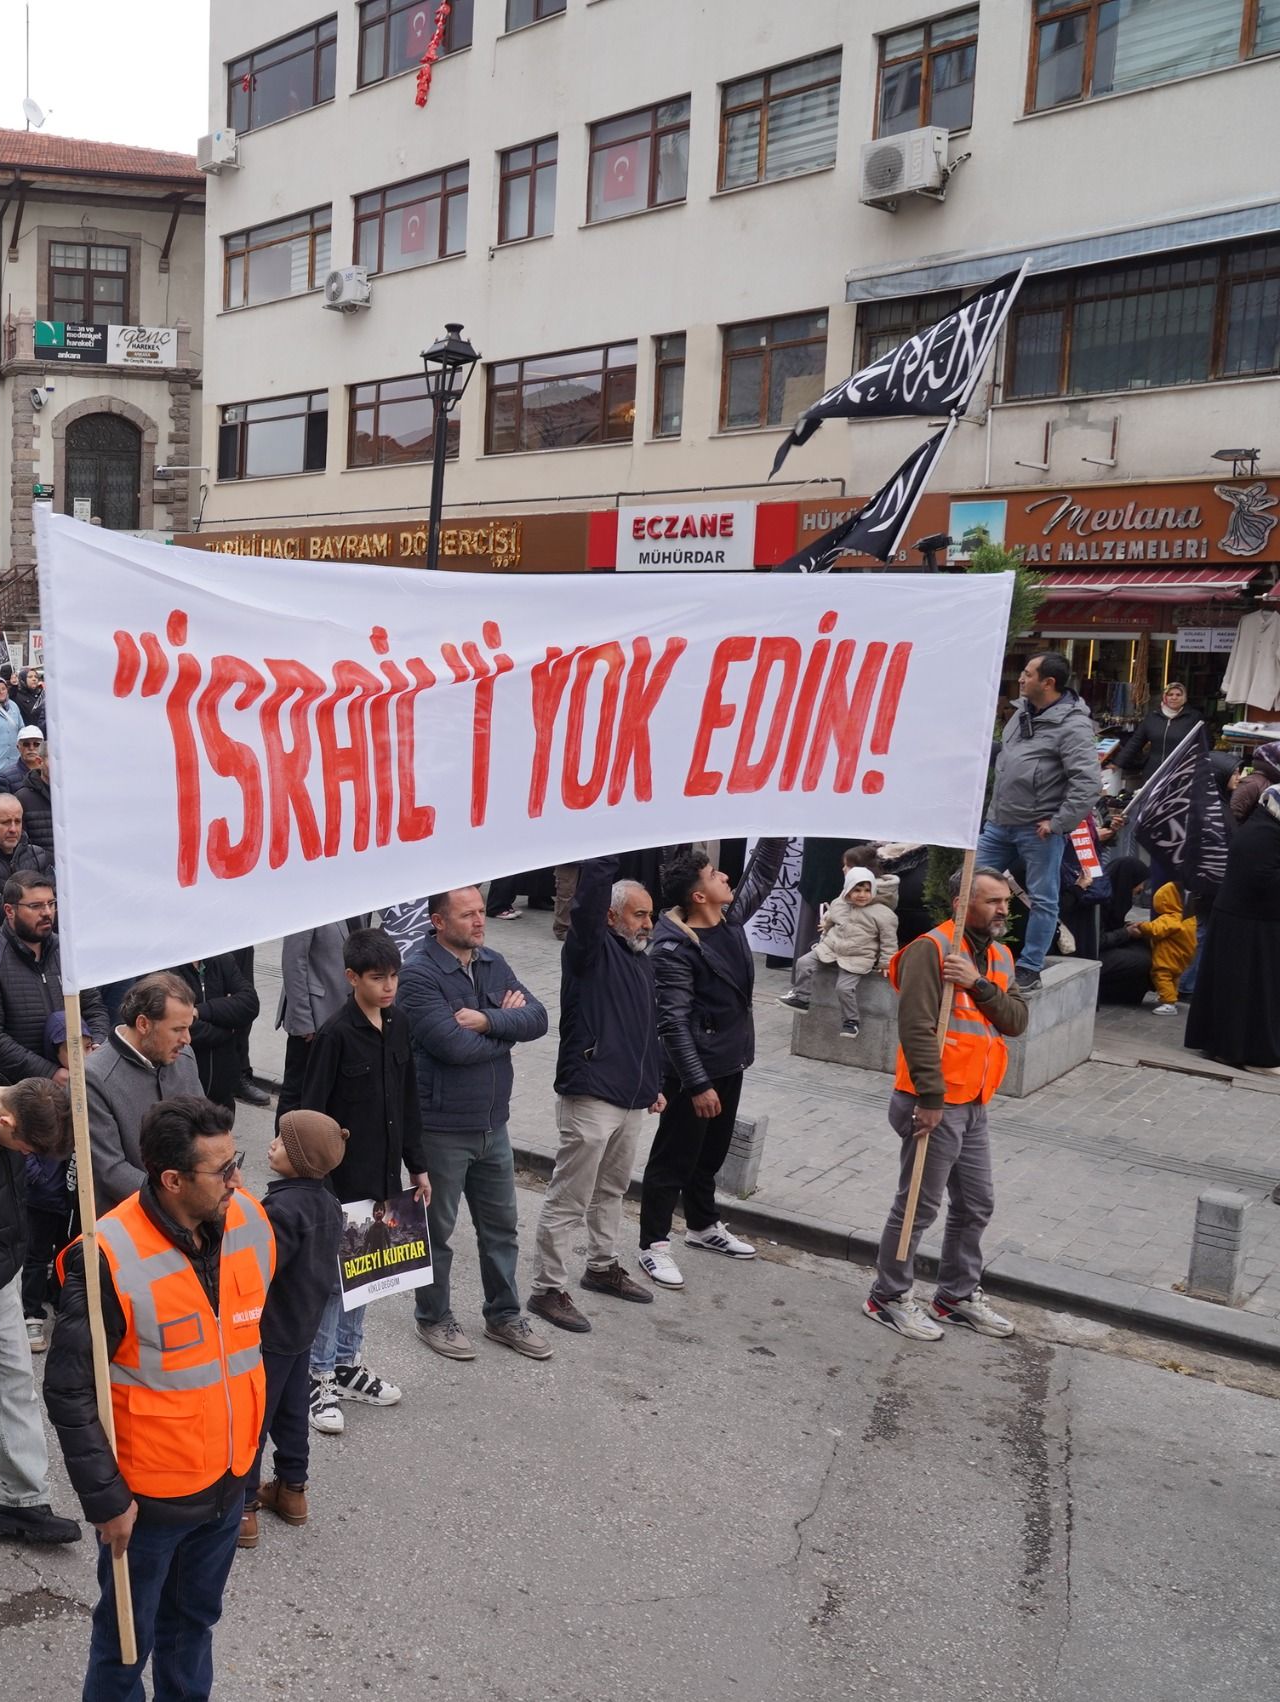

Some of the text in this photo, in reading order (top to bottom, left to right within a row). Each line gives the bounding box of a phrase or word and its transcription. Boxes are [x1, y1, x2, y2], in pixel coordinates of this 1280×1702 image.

[58, 351, 81, 360] ankara
[67, 340, 95, 348] hareketi
[632, 513, 734, 540] ECZANE
[1025, 494, 1202, 536] Mevlana
[309, 534, 388, 559] BAYRAM
[399, 522, 517, 557] DÖERCİSİ
[1058, 537, 1209, 561] MALZEMELERİ
[639, 549, 725, 564] MÜHÜRDAR
[528, 635, 688, 819] YOK
[682, 609, 913, 797] EDİN!
[344, 1240, 427, 1279] GAZZEYİ KURTAR
